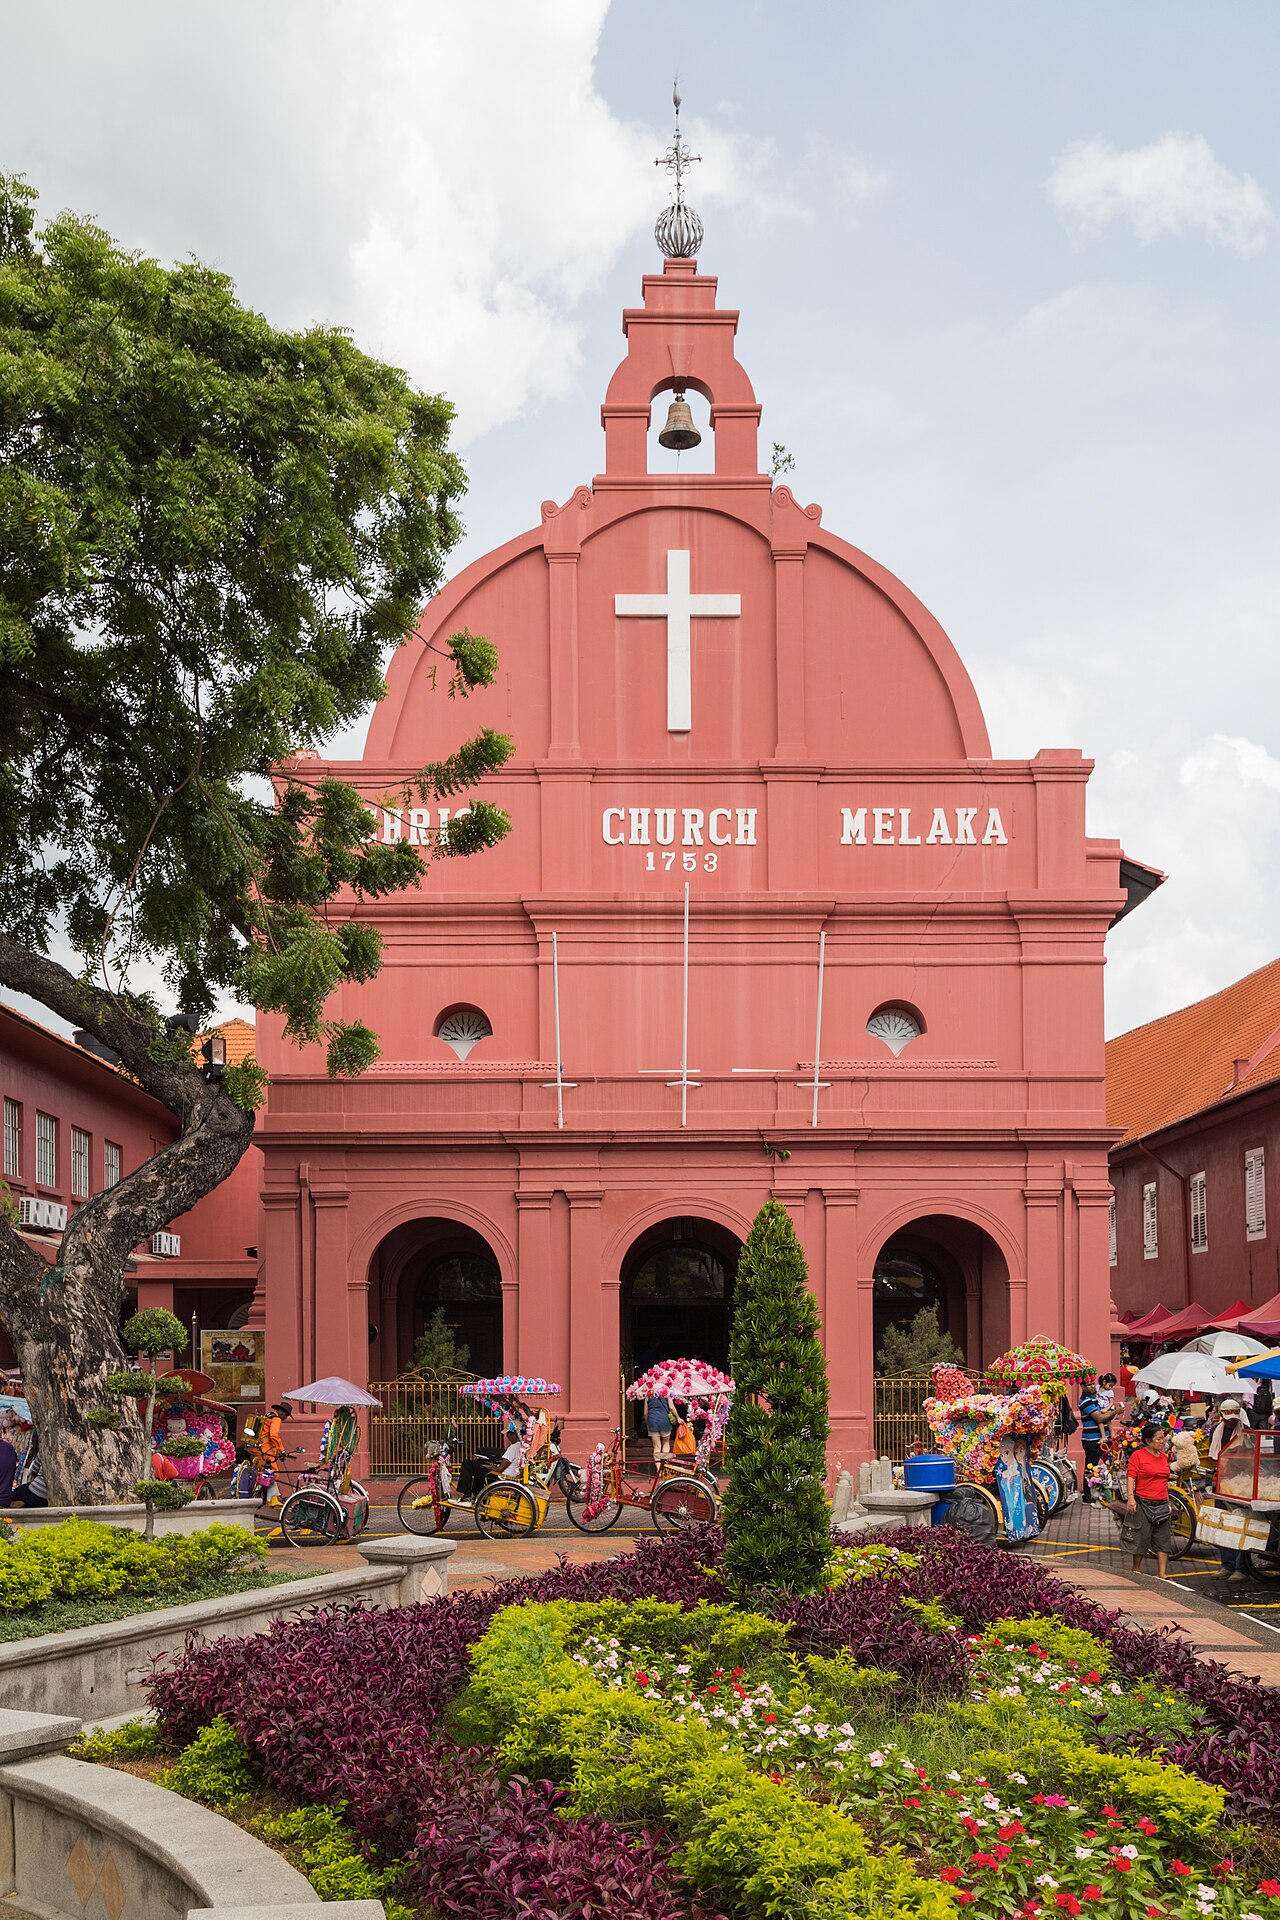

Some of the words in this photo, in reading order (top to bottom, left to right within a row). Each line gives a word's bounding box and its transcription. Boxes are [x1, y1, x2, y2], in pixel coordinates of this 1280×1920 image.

[602, 808, 758, 845] CHURCH
[840, 808, 1008, 845] MELAKA
[646, 852, 718, 872] 1753
